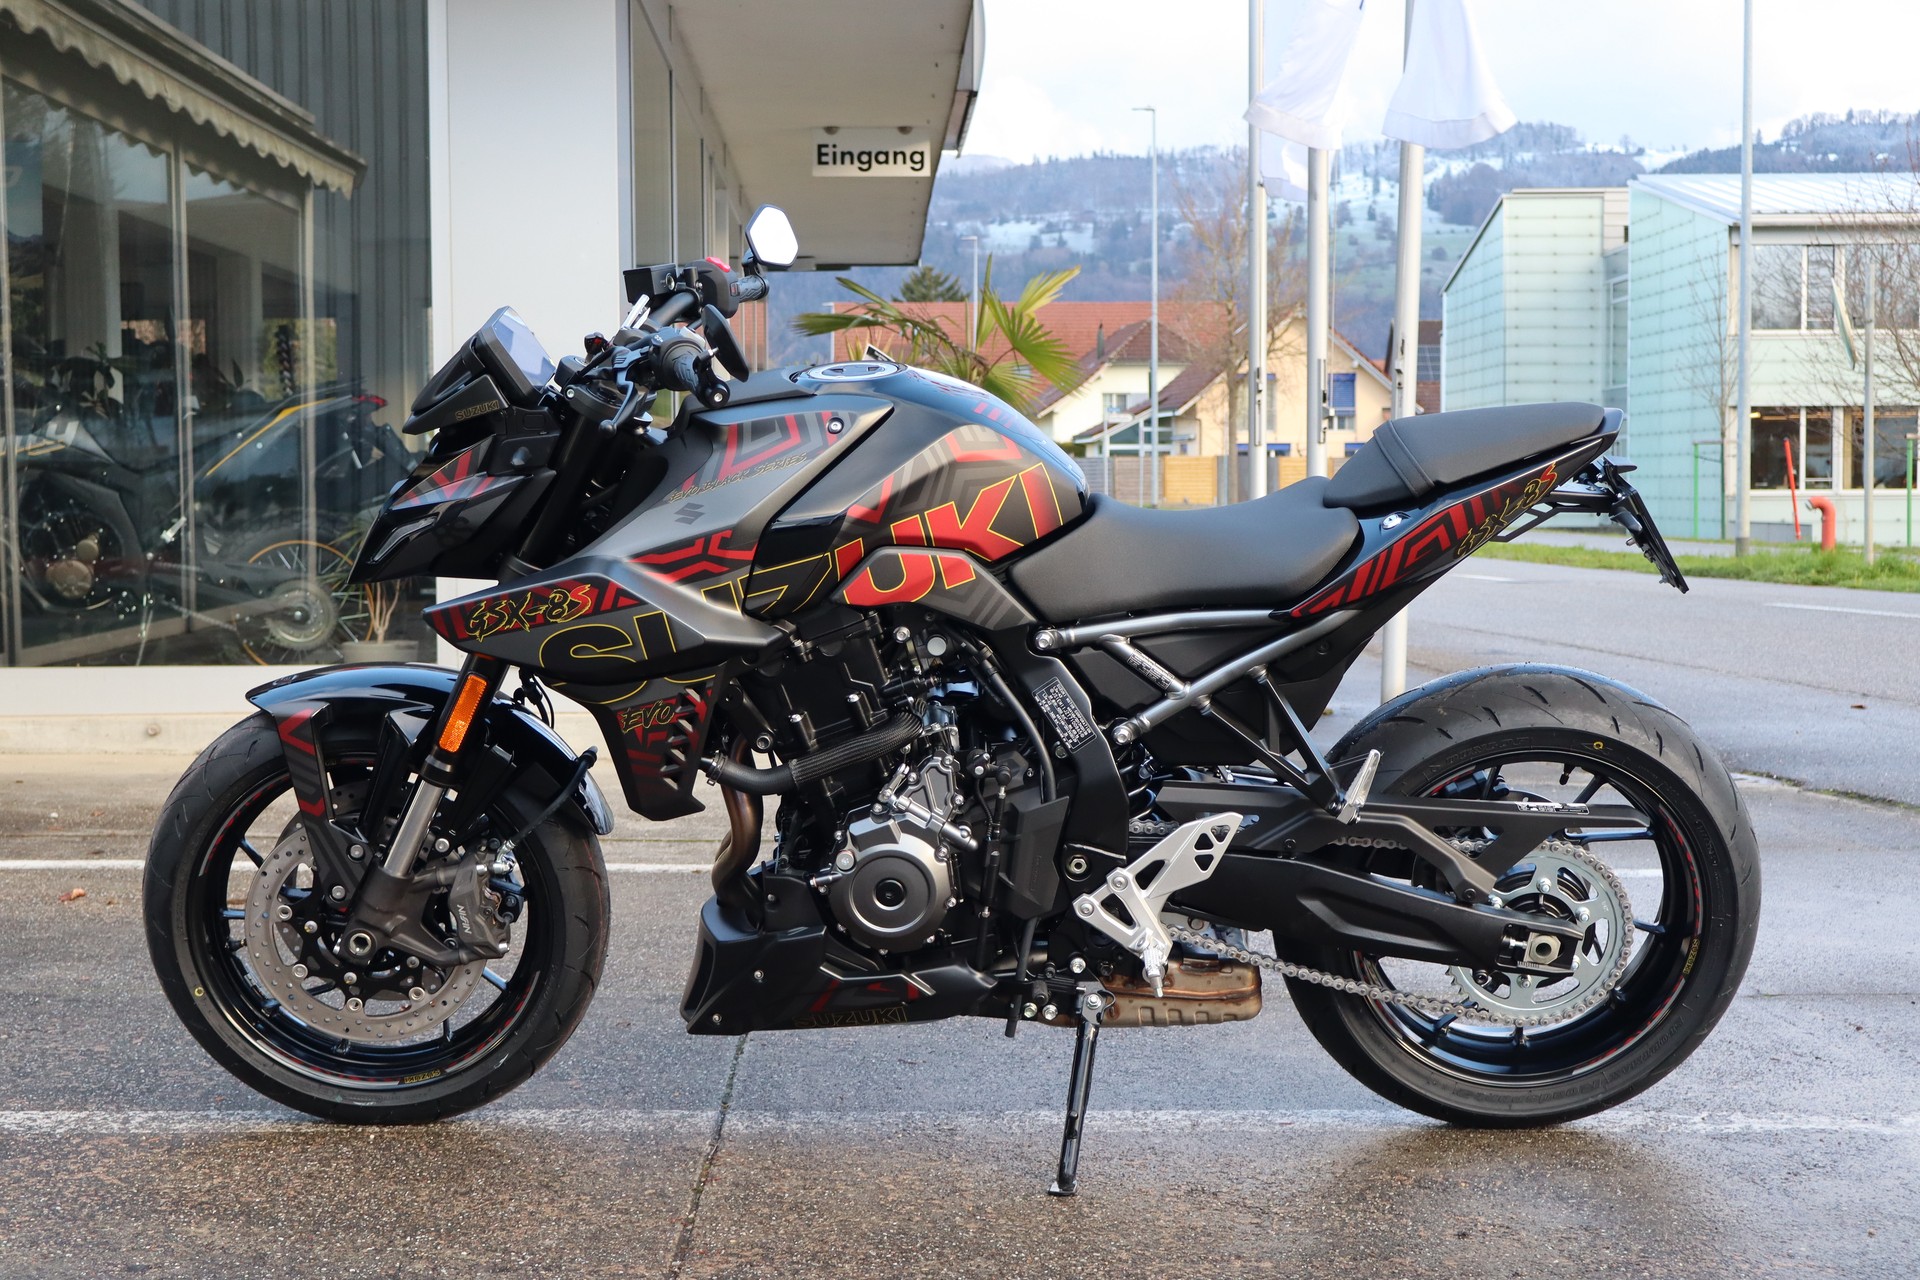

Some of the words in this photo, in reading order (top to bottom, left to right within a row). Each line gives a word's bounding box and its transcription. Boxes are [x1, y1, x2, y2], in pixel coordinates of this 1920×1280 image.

[817, 144, 925, 172] Eingang
[455, 400, 500, 421] SUZUKI
[669, 485, 701, 504] EVO
[700, 470, 750, 494] BLACK
[751, 452, 808, 478] SERIES
[465, 584, 592, 643] GSX-8S
[621, 699, 675, 735] EVO
[1682, 938, 1700, 975] SUZUKI
[791, 1005, 908, 1028] SUZUKI
[403, 1069, 442, 1084] SUZUKI
